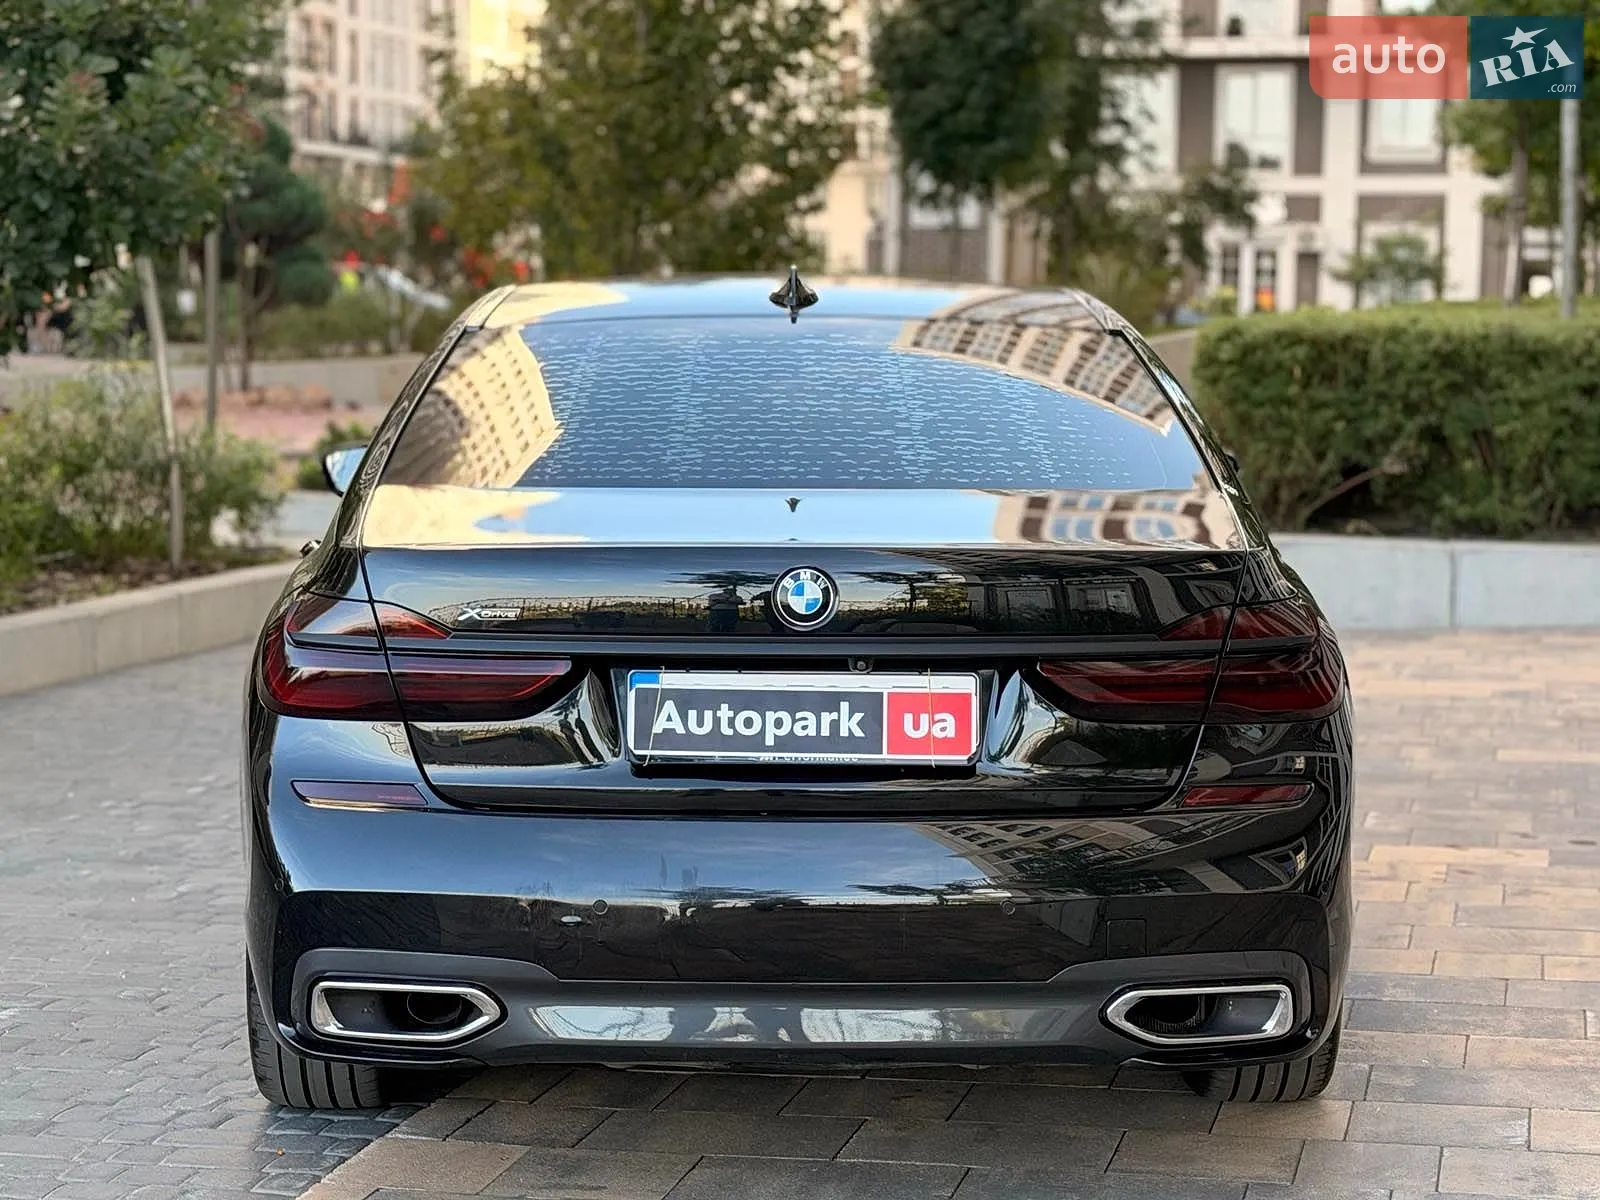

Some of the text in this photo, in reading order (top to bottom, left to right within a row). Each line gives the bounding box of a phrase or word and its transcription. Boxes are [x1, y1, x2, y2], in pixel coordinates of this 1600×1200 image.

[783, 571, 828, 589] BMW
[652, 699, 956, 746] Autopark ua
